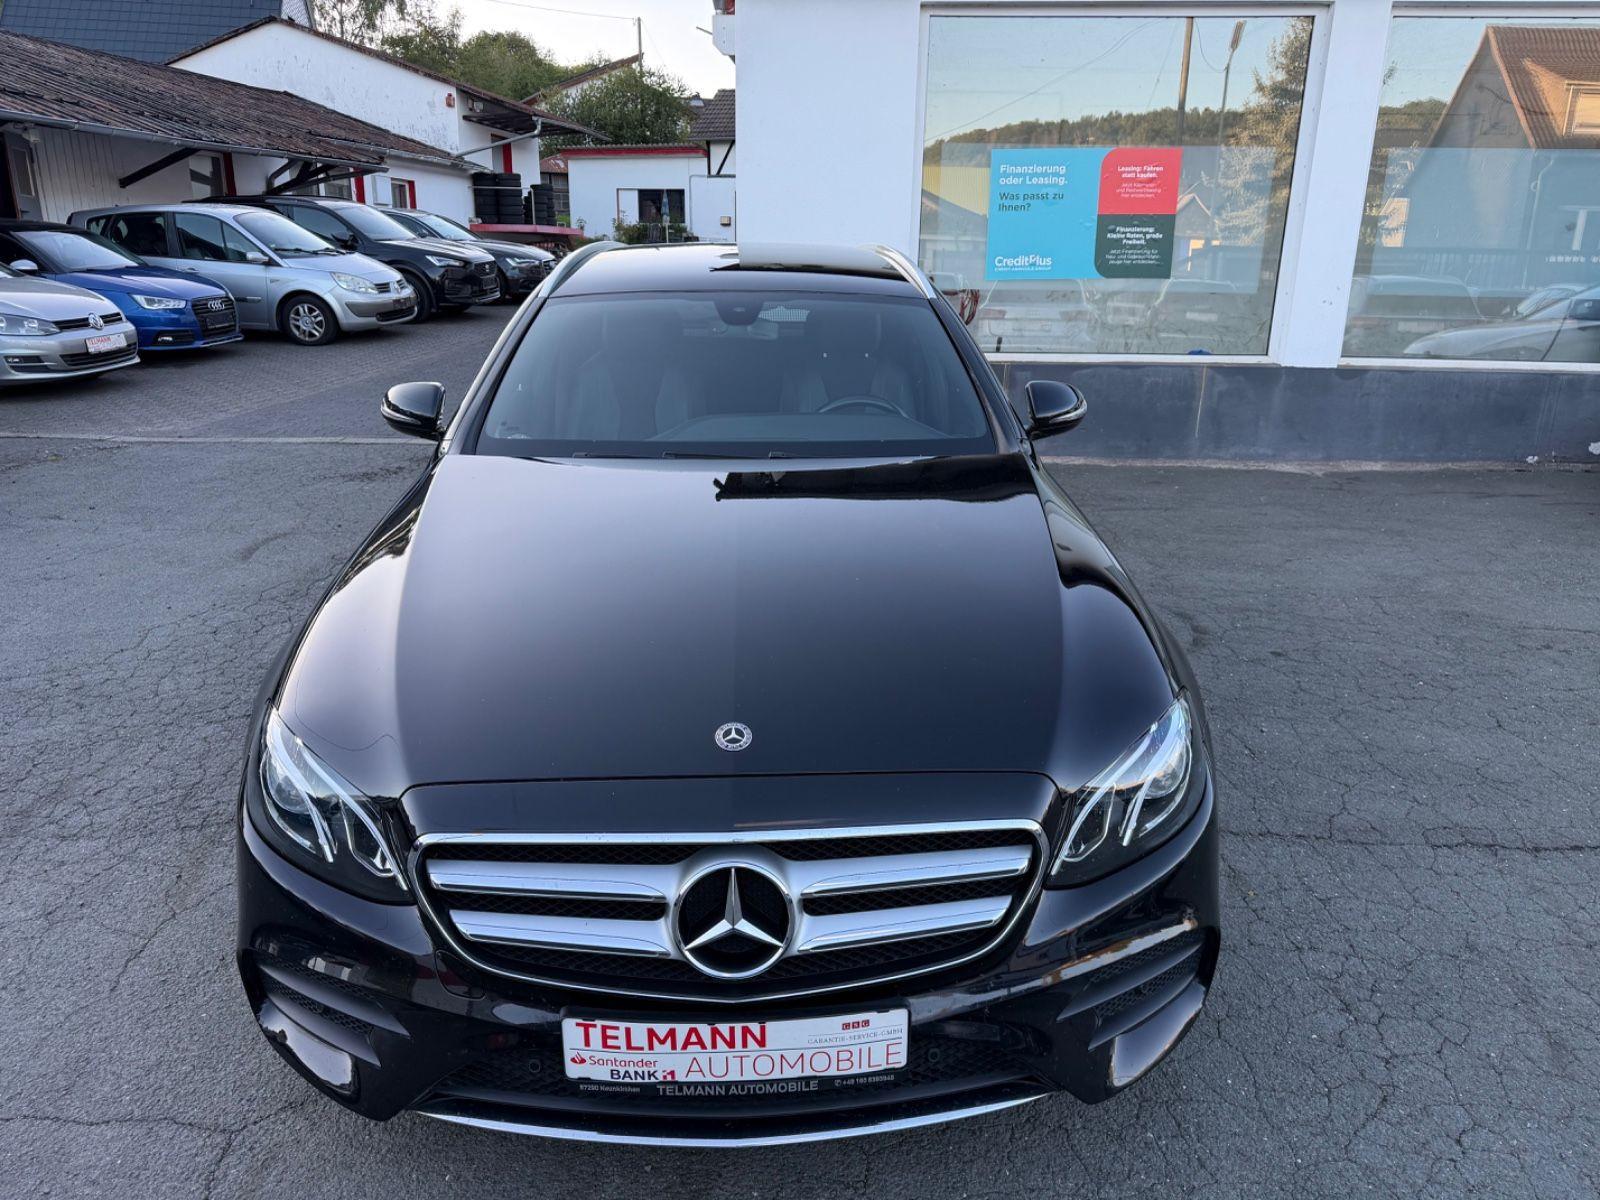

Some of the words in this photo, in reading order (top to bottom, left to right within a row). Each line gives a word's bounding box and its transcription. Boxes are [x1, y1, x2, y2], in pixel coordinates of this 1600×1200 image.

[1000, 163, 1066, 174] Finanzierung
[1000, 176, 1024, 185] oder
[1026, 175, 1068, 186] Leasing.
[999, 192, 1020, 201] Was
[1023, 192, 1049, 202] passt
[1053, 192, 1064, 200] zu
[999, 203, 1031, 212] Ihnen?
[994, 254, 1052, 267] CreditPlus
[575, 1022, 767, 1051] TELMANN
[589, 1056, 659, 1068] Santander
[685, 1042, 902, 1079] AUTOMOBILE
[657, 1085, 727, 1096] TELMANN
[728, 1080, 819, 1095] AUTOMOBILE
